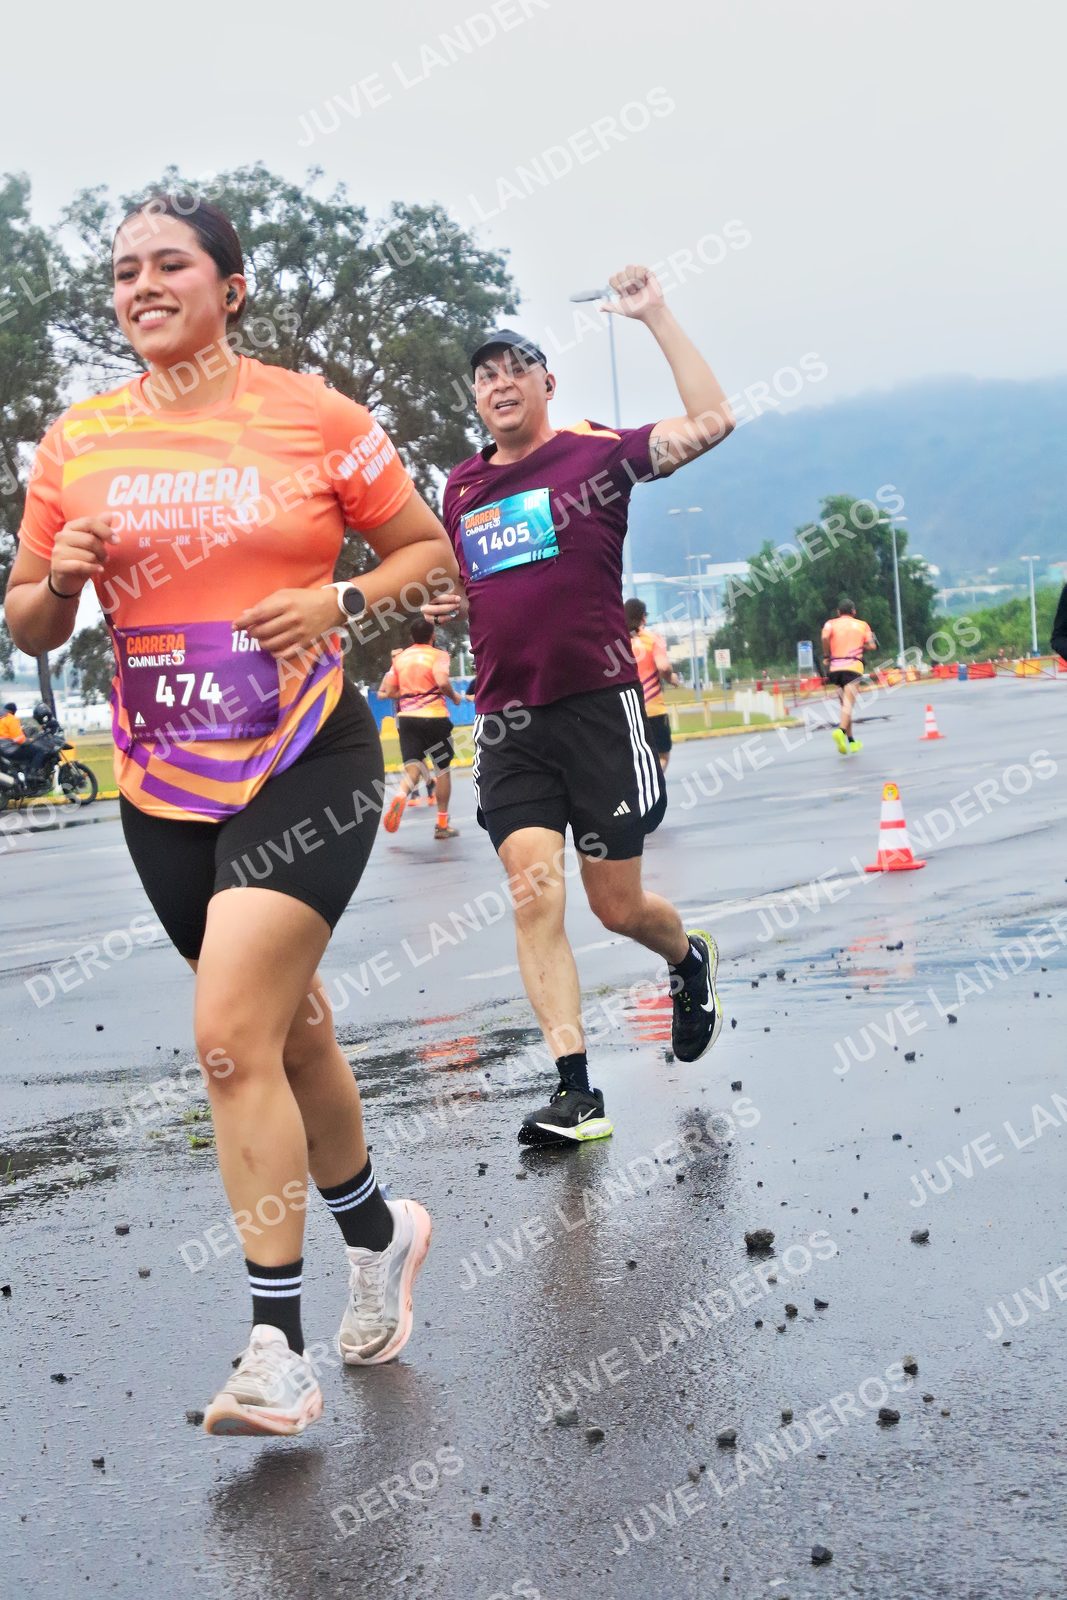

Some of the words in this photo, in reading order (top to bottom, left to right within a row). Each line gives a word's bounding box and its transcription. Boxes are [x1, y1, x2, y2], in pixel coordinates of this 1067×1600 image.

[106, 466, 260, 507] CARRERA
[465, 507, 500, 529] CARRERA
[477, 522, 531, 555] 1405
[126, 633, 186, 655] CARRERA
[155, 672, 223, 707] 474
